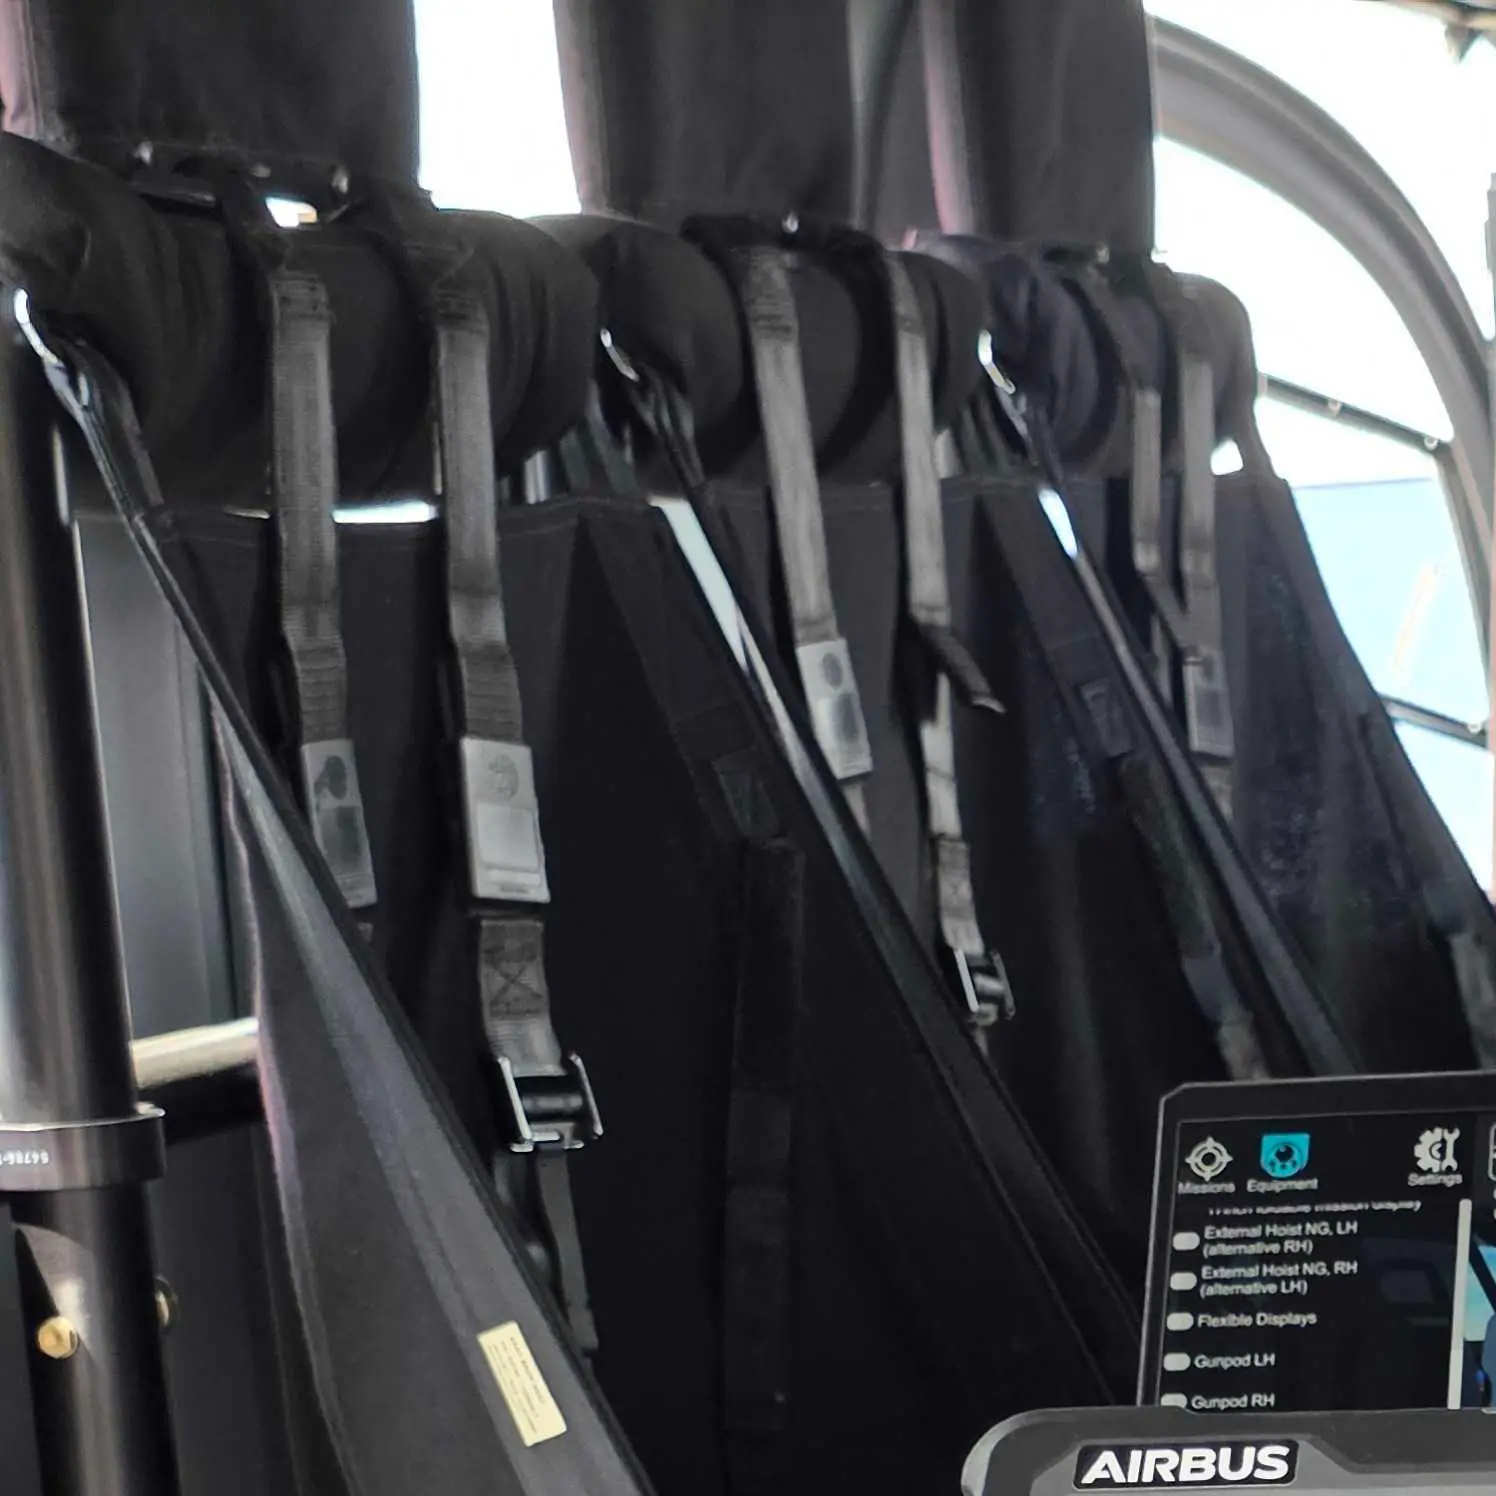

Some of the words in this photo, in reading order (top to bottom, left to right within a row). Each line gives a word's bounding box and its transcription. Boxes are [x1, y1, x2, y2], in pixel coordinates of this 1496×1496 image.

[1247, 1178, 1318, 1195] Equipment
[1408, 1172, 1463, 1188] Settings
[1205, 1225, 1262, 1240] External
[1265, 1223, 1301, 1238] Hoist
[1305, 1221, 1333, 1237] NG,
[1337, 1221, 1358, 1234] LH
[1203, 1241, 1280, 1258] (alternative
[1284, 1239, 1313, 1256] RH)
[1201, 1265, 1259, 1280] External
[1263, 1262, 1299, 1277] Hoist
[1302, 1261, 1330, 1277] NG,
[1334, 1260, 1358, 1274] RH
[1200, 1281, 1278, 1299] (alternative
[1280, 1279, 1308, 1296] LH)
[1197, 1313, 1253, 1328] Flexible
[1256, 1311, 1317, 1328] Displays
[1194, 1355, 1250, 1371] Gunpod
[1254, 1353, 1276, 1367] LH
[1191, 1395, 1247, 1410] Gunpod
[1251, 1393, 1275, 1407] RH
[1081, 1445, 1290, 1484] AIRBUS
